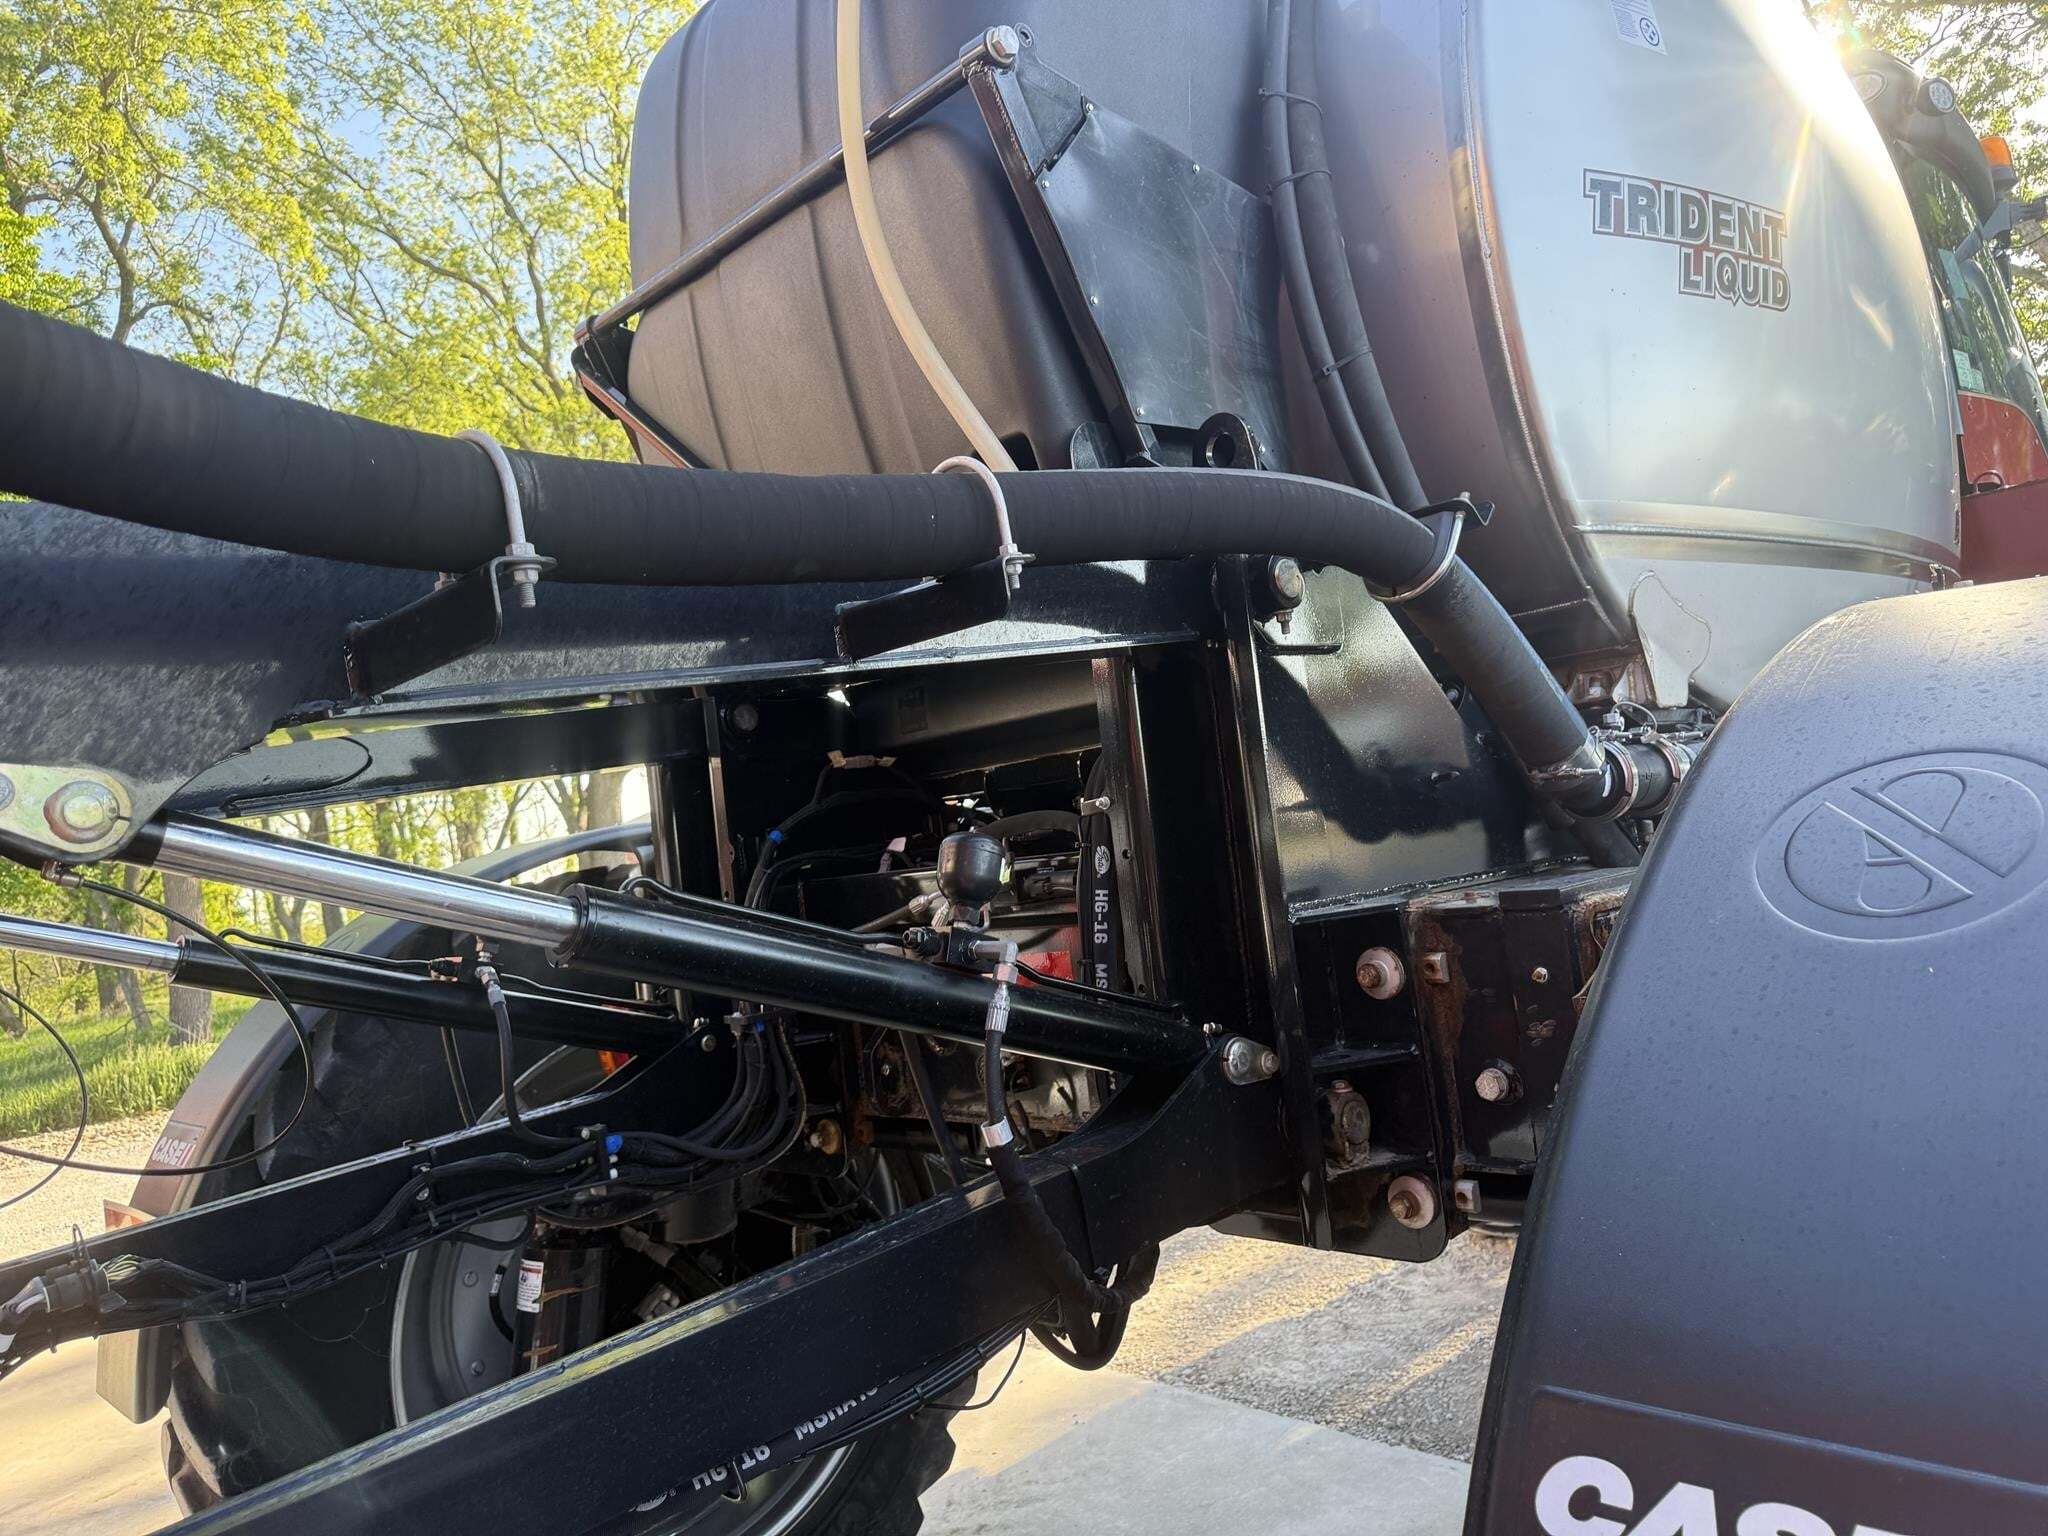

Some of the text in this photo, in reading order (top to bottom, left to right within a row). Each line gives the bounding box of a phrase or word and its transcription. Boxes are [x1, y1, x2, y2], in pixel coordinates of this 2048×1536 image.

[1583, 168, 1787, 264] TRIDENT
[1678, 245, 1791, 311] LIQUID
[1094, 889, 1109, 944] HG-16
[1095, 963, 1109, 993] MS
[151, 1136, 188, 1166] CASE
